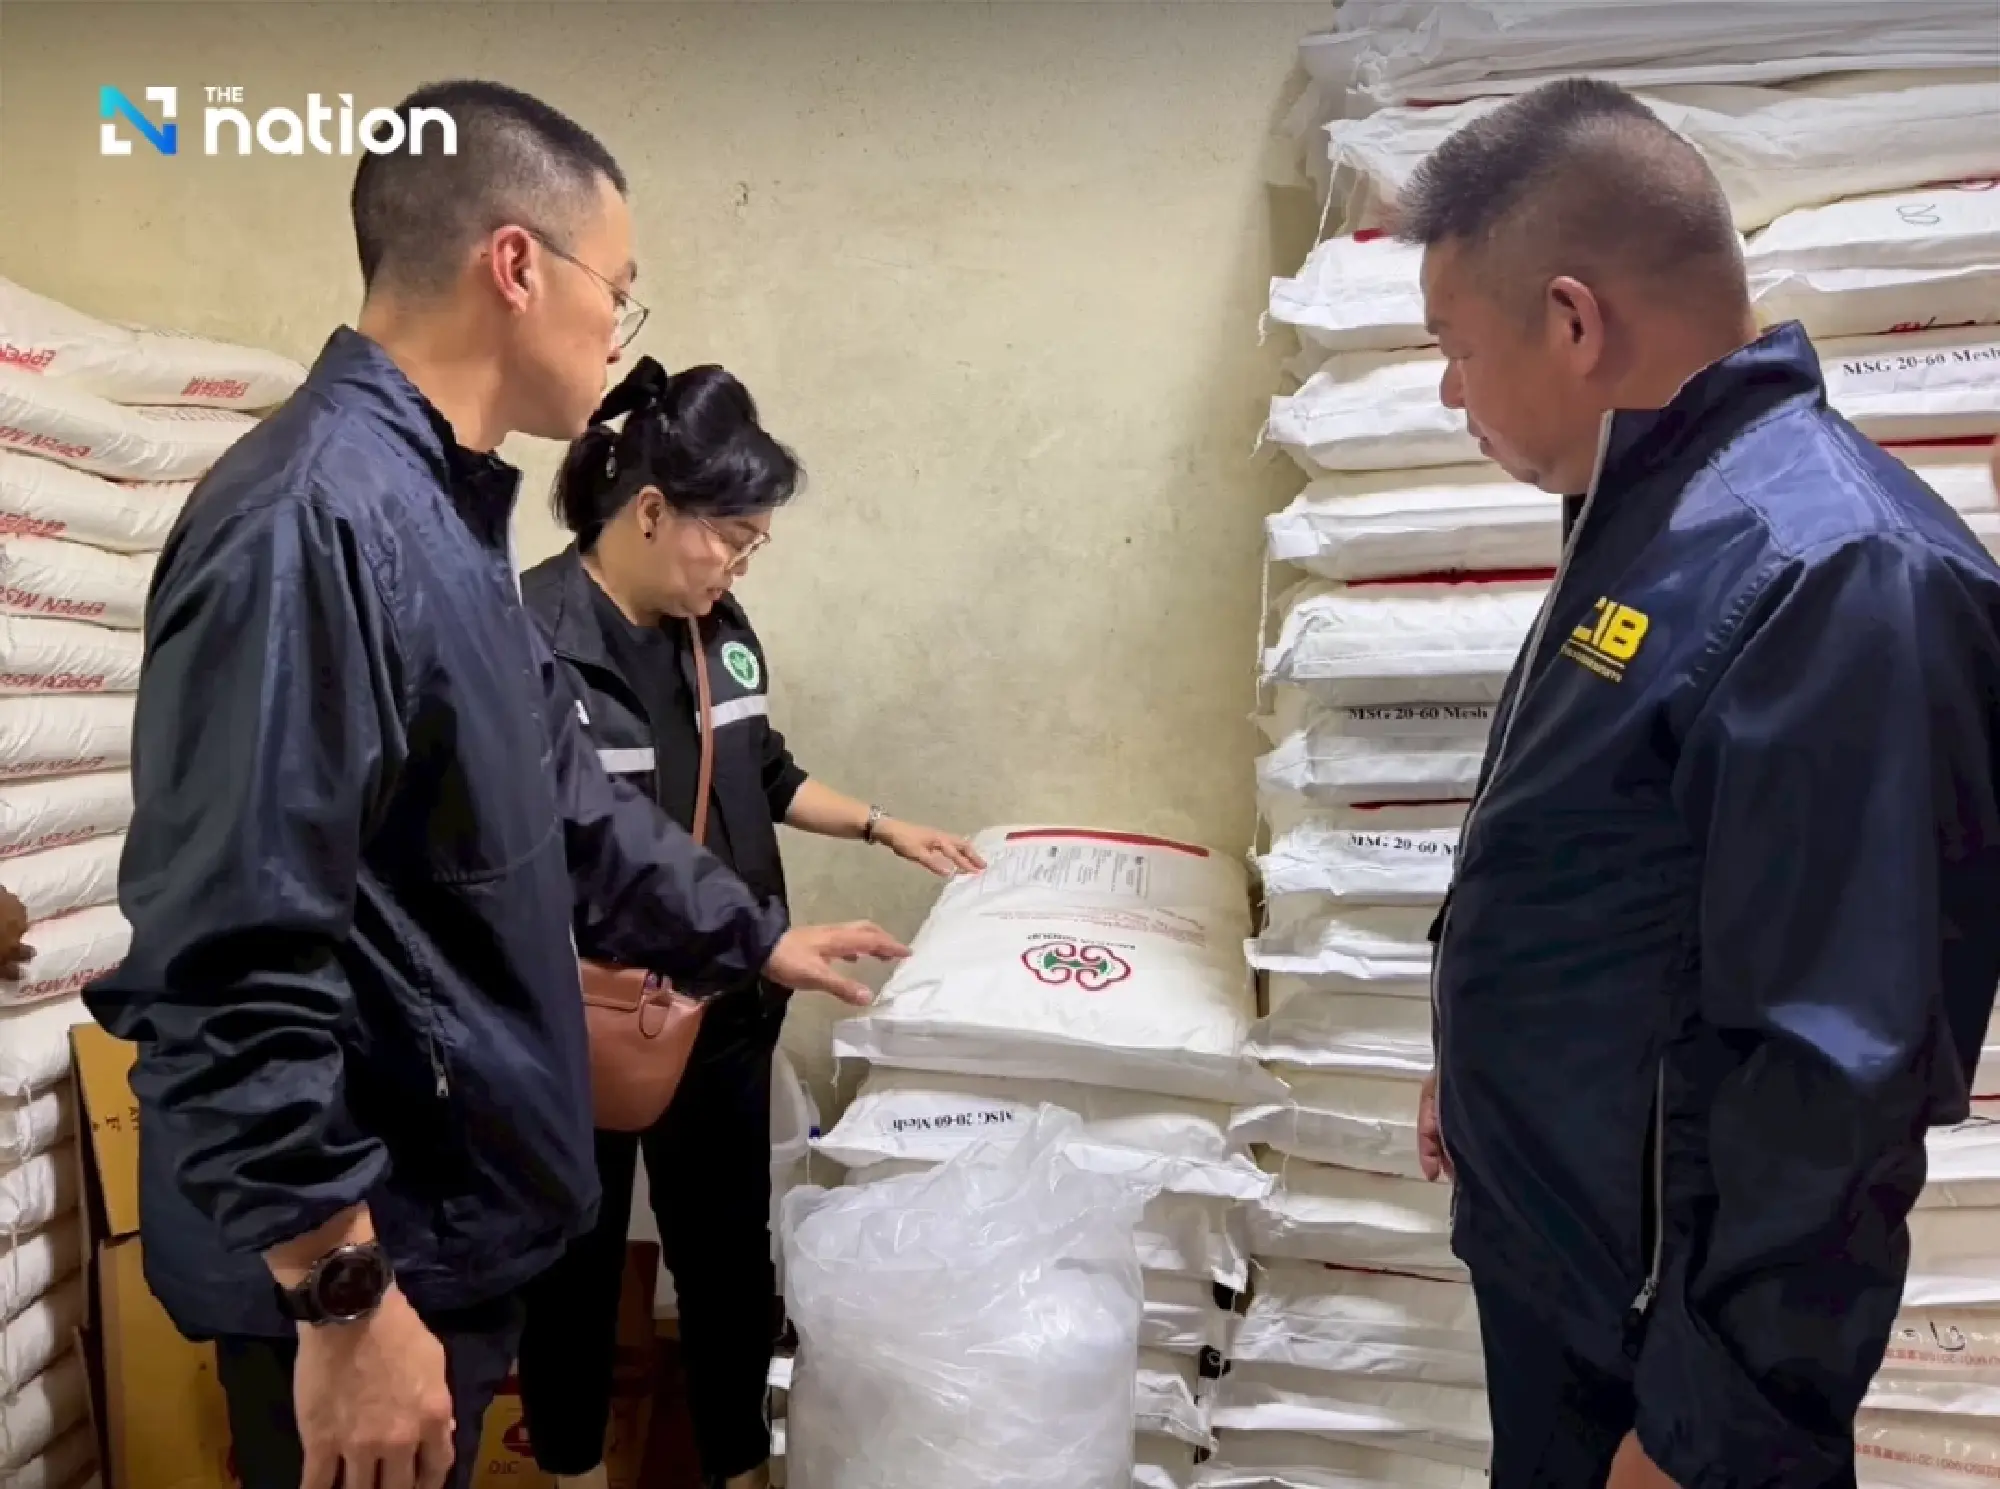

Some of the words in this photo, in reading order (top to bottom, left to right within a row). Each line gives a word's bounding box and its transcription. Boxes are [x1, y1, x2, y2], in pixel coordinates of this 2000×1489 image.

[1843, 359, 1891, 376] MSG
[1897, 353, 1946, 369] 20-60
[1348, 706, 1391, 720] MSG
[1395, 705, 1440, 720] 20-60
[1443, 705, 1487, 720] Mesh
[1348, 830, 1389, 848] MSG
[1393, 836, 1438, 854] 20-60
[893, 1117, 932, 1132] Mesh
[935, 1112, 973, 1128] 20-60
[977, 1109, 1015, 1125] MSG
